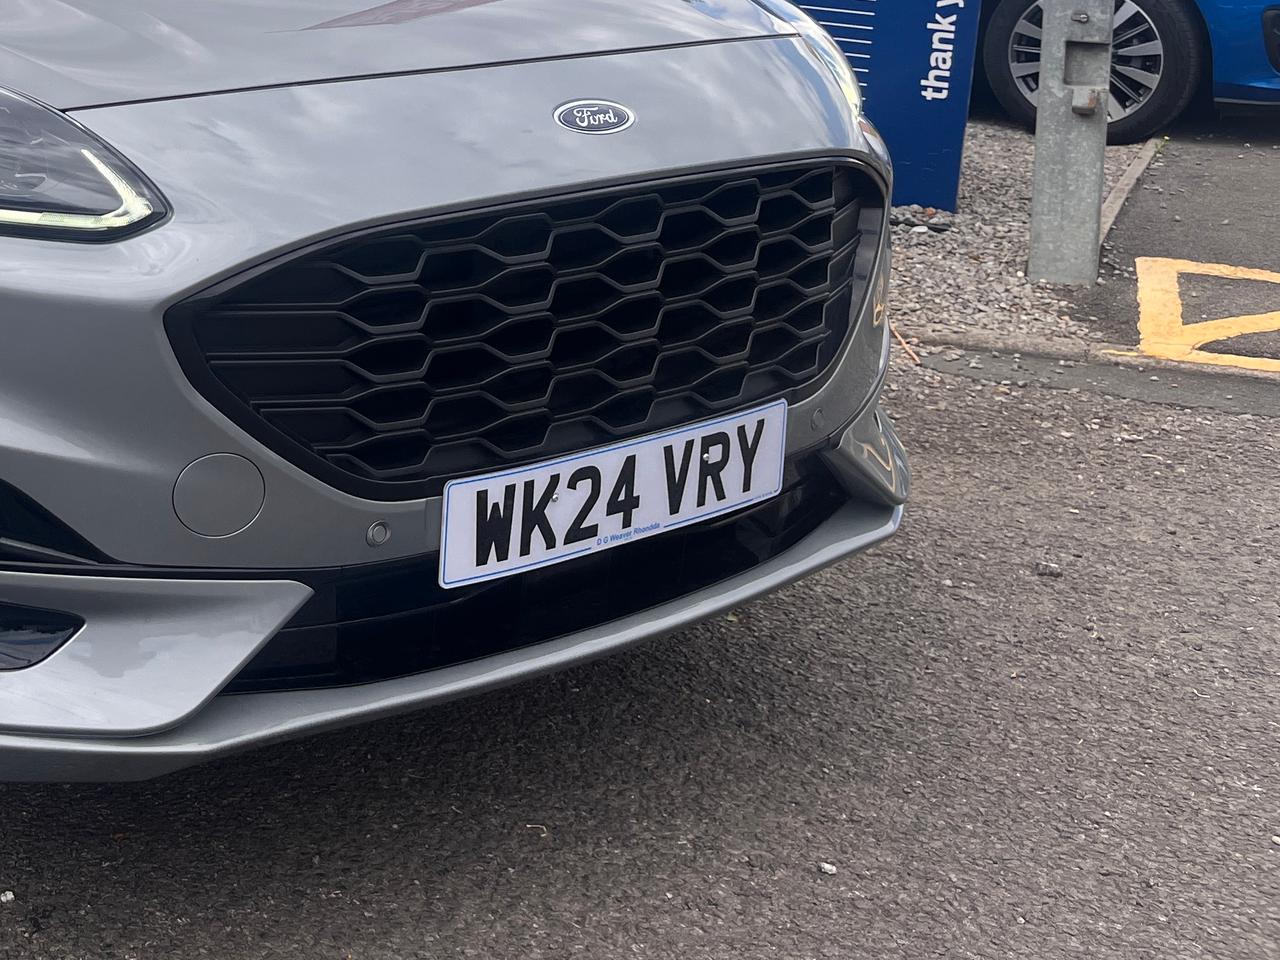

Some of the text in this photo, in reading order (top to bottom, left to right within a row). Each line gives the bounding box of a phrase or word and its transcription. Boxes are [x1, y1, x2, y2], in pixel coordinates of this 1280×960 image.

[920, 13, 958, 100] thank
[475, 419, 765, 567] WK24 VRY
